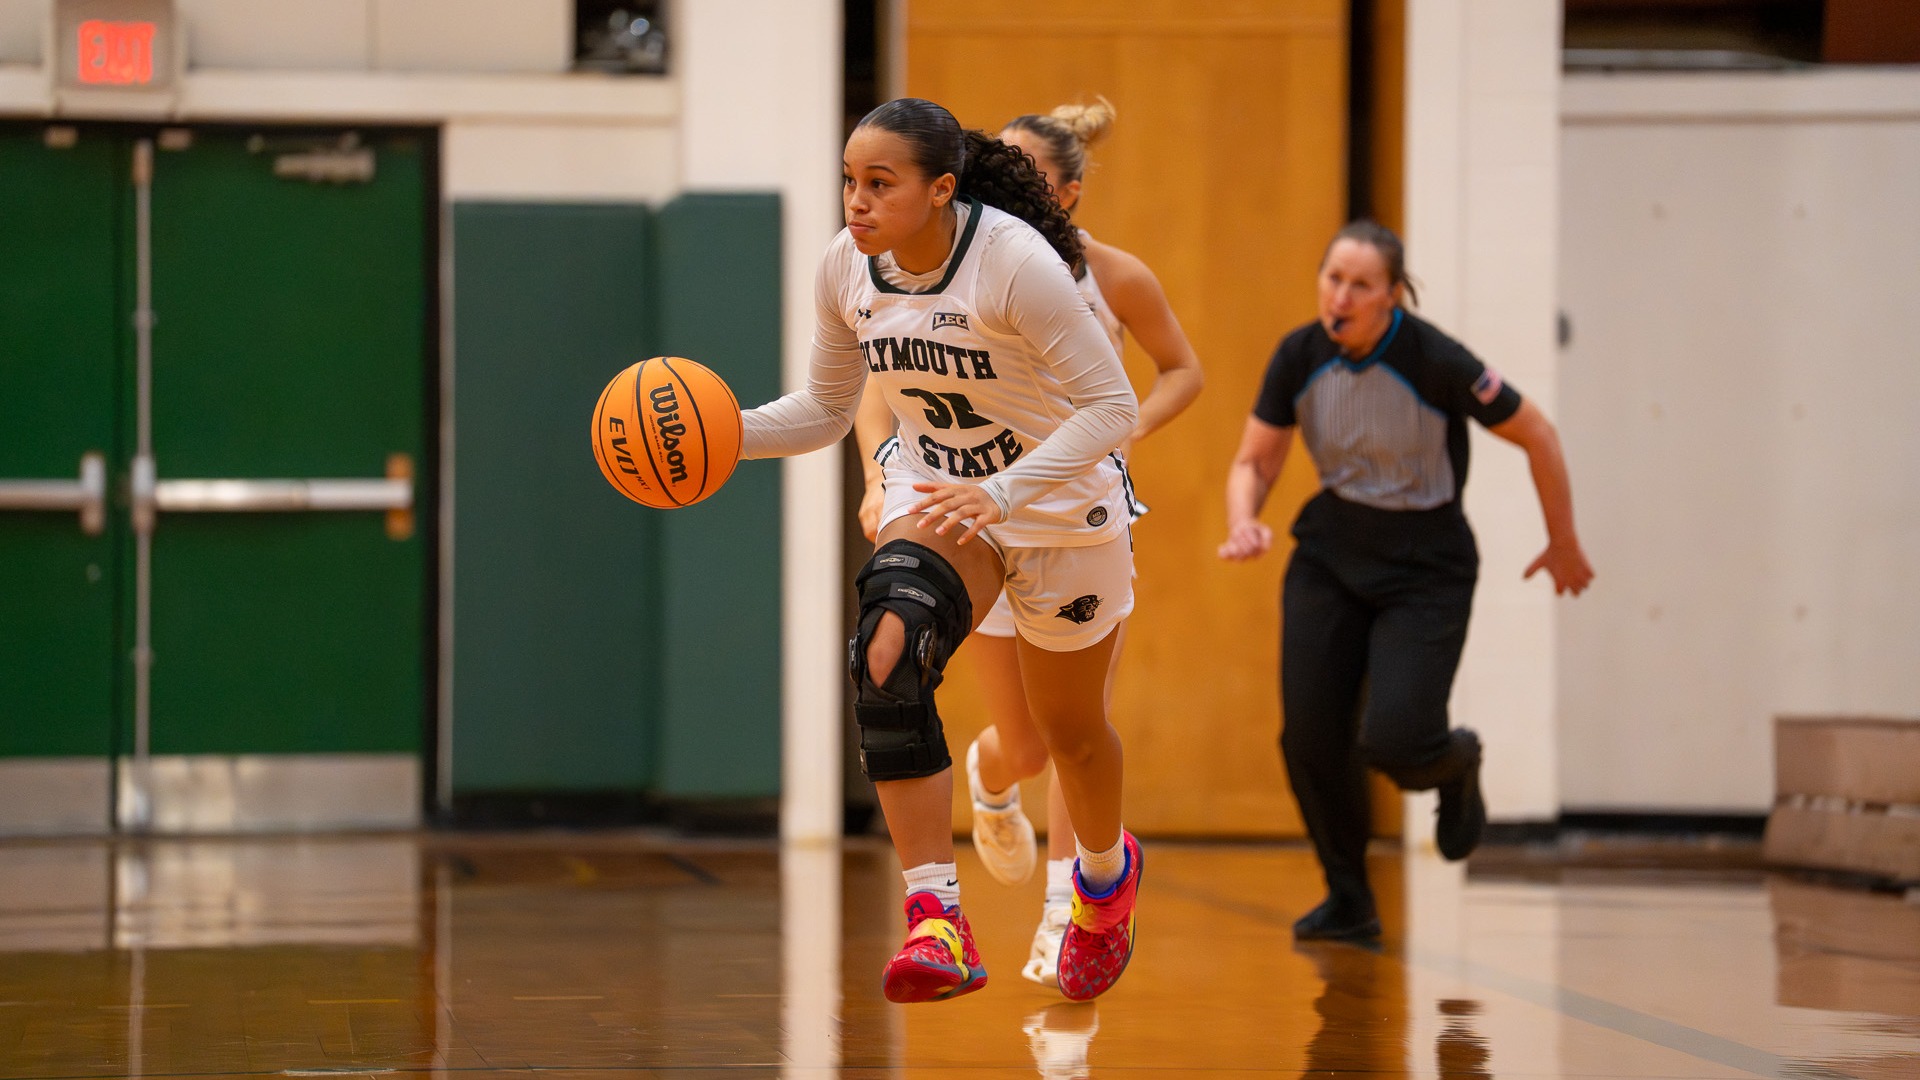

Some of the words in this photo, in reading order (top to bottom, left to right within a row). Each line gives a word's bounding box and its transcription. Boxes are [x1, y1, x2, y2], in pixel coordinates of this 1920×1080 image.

[934, 314, 968, 327] LEC
[609, 416, 640, 475] EVO
[635, 475, 652, 491] NXT
[649, 382, 688, 484] Wilson
[918, 428, 1024, 478] STATE
